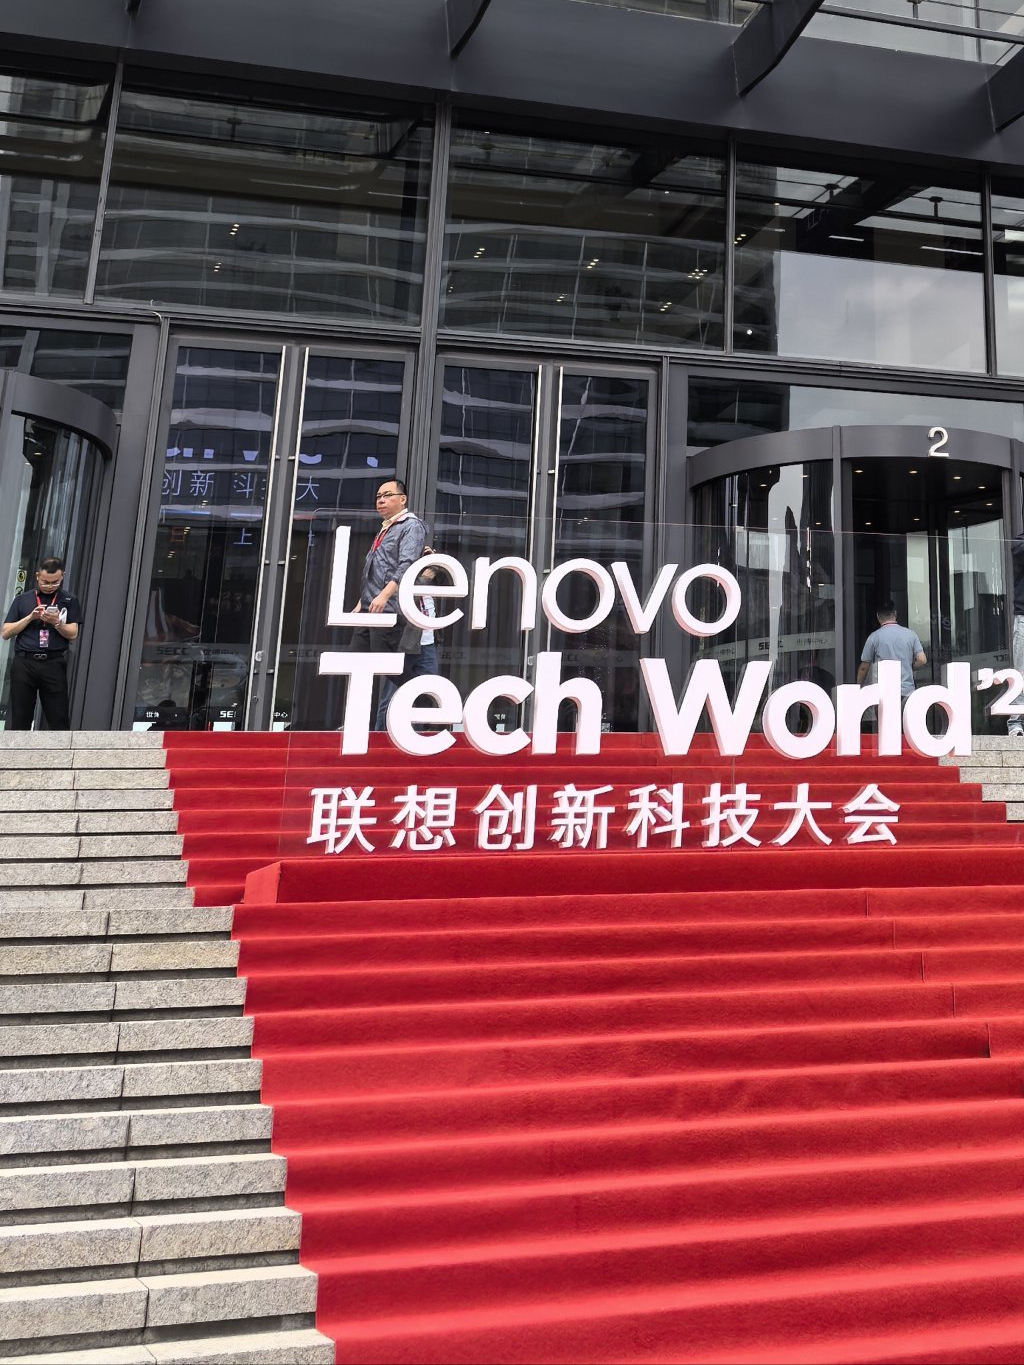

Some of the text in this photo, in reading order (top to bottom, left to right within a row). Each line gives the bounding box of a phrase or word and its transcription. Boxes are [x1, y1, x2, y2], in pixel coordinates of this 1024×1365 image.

[928, 426, 949, 457] 2
[326, 525, 742, 637] Lenovo
[318, 652, 603, 756] Tech
[639, 658, 973, 759] World
[306, 782, 901, 855] 联想创新科技大会
